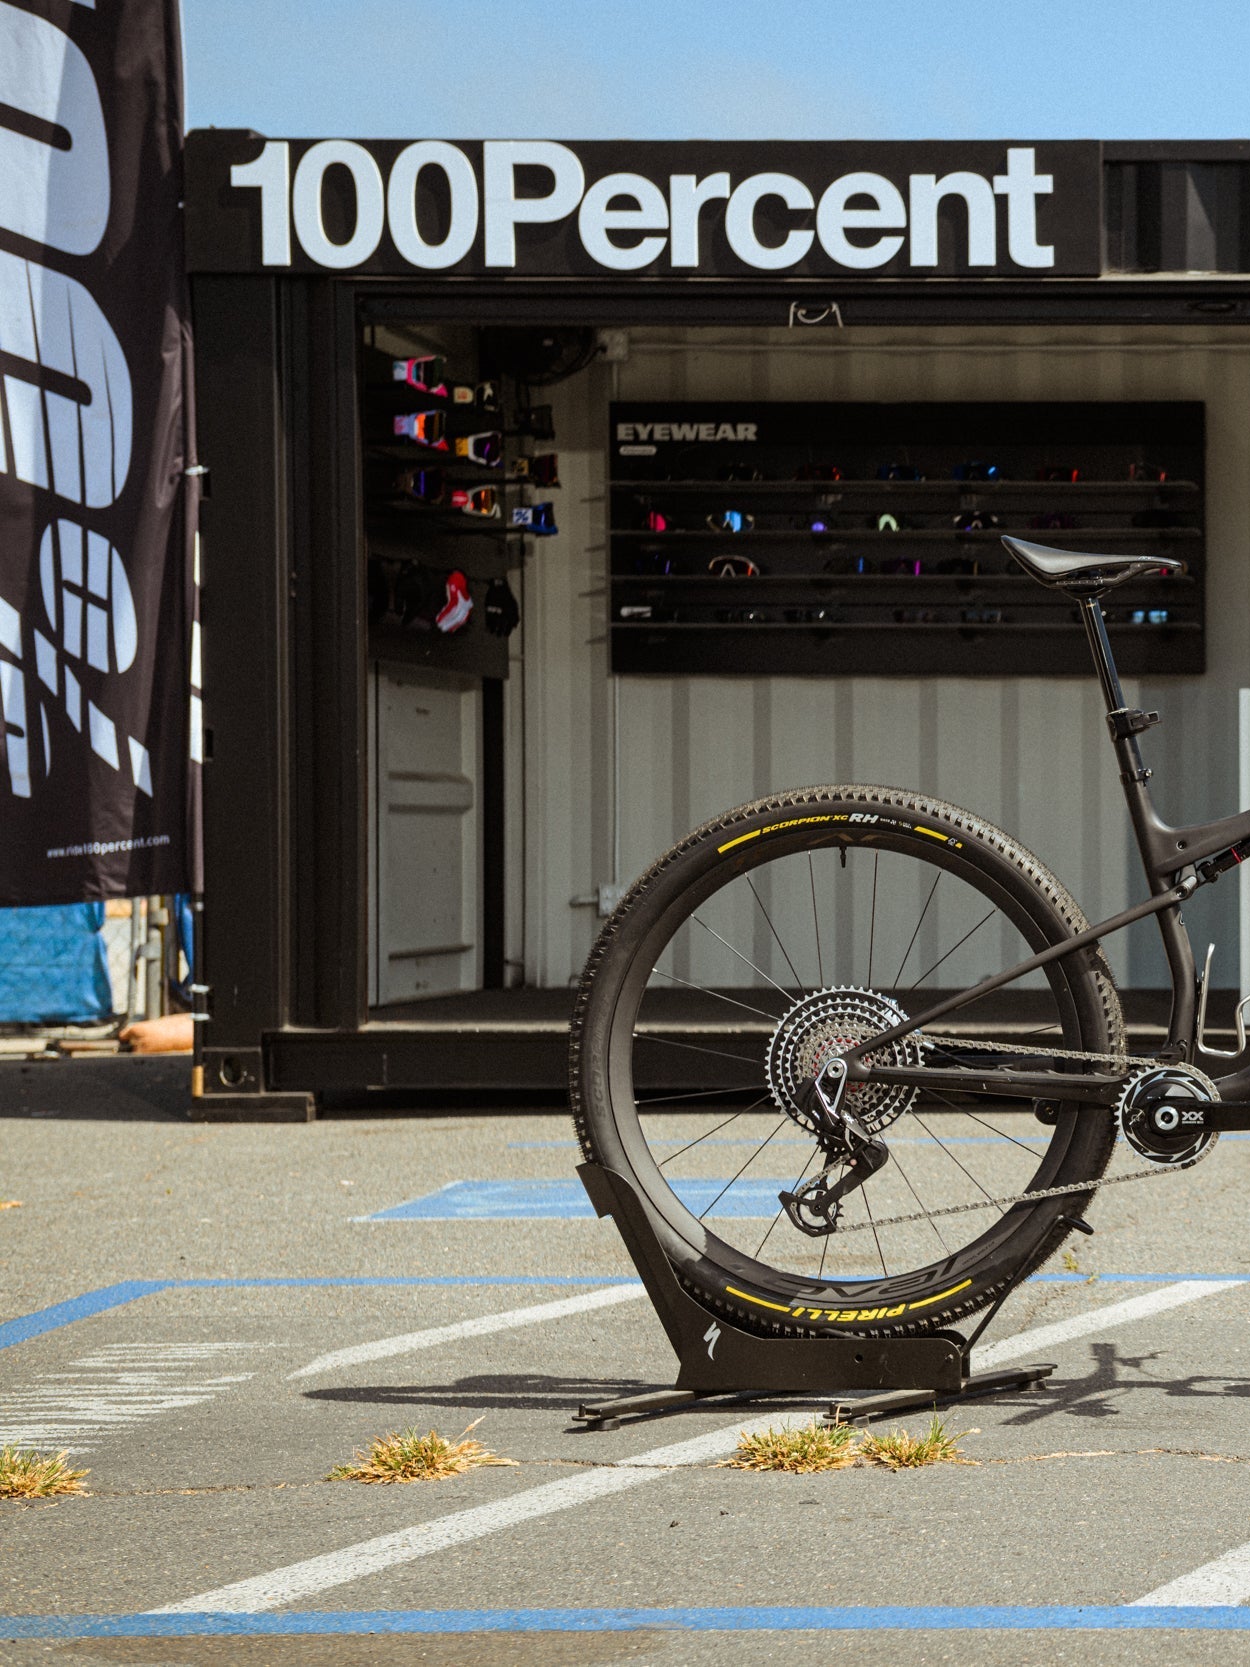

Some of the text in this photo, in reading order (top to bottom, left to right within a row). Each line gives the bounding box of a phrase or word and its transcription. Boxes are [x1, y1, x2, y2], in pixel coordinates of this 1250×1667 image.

[230, 139, 1055, 270] 100Percent
[616, 422, 758, 441] EYEWEAR
[762, 815, 830, 834] SCORPION
[848, 812, 880, 824] RH
[791, 1303, 907, 1322] PIRELLI
